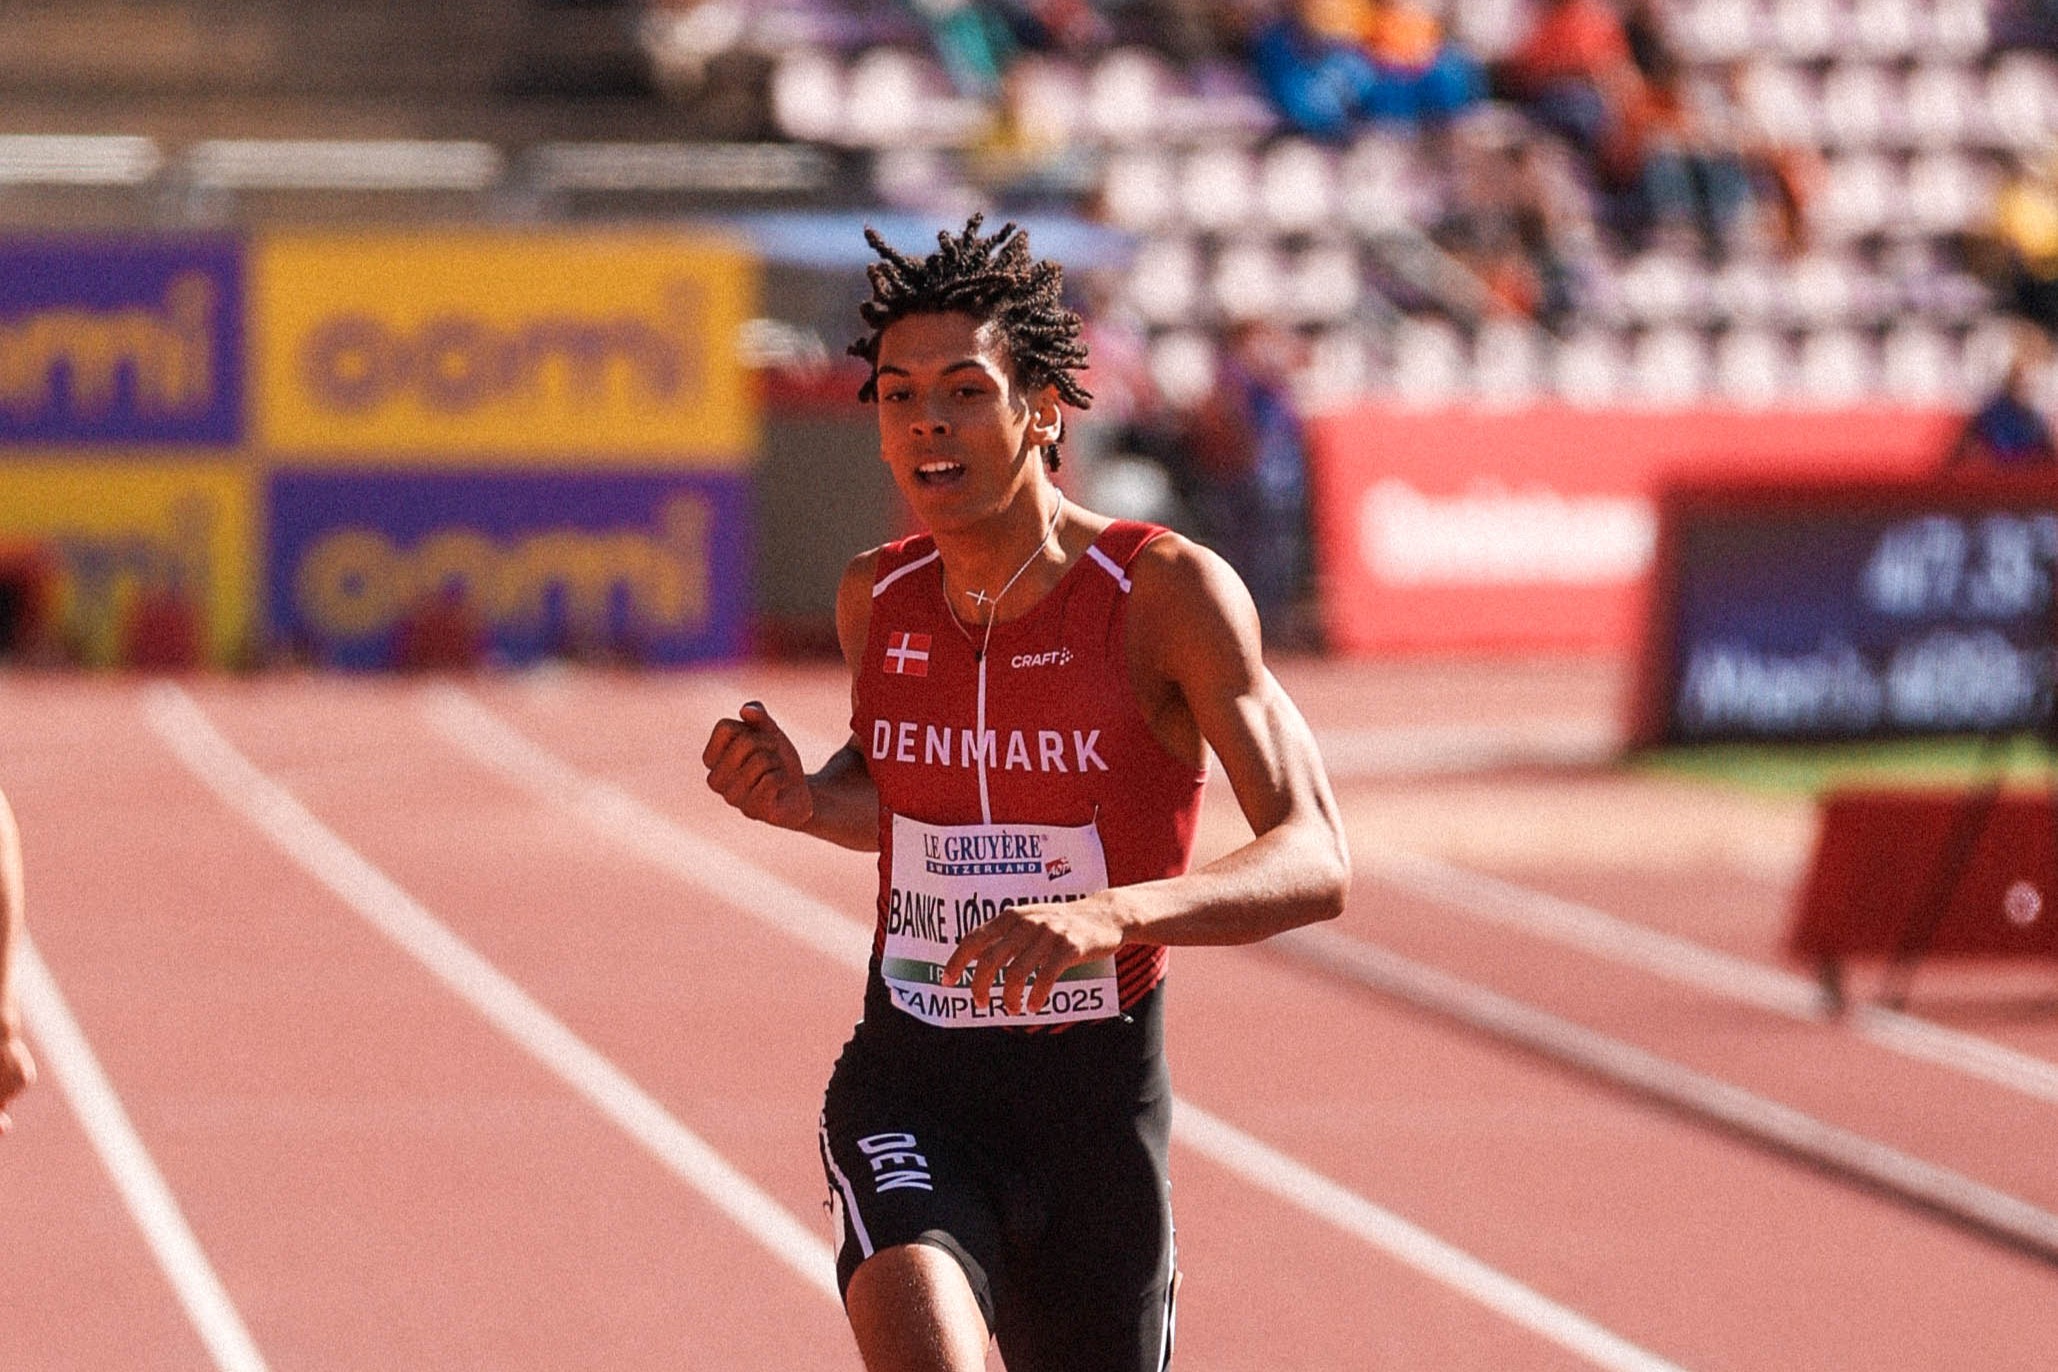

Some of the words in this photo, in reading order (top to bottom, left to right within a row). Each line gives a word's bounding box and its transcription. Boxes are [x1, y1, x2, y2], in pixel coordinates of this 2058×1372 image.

[1011, 650, 1061, 669] CRAFT
[872, 719, 1109, 772] DENMARK
[924, 833, 942, 859] LE
[929, 863, 1036, 875] SWITZERLAND
[888, 888, 948, 944] BANKE
[857, 1133, 933, 1192] DEN
